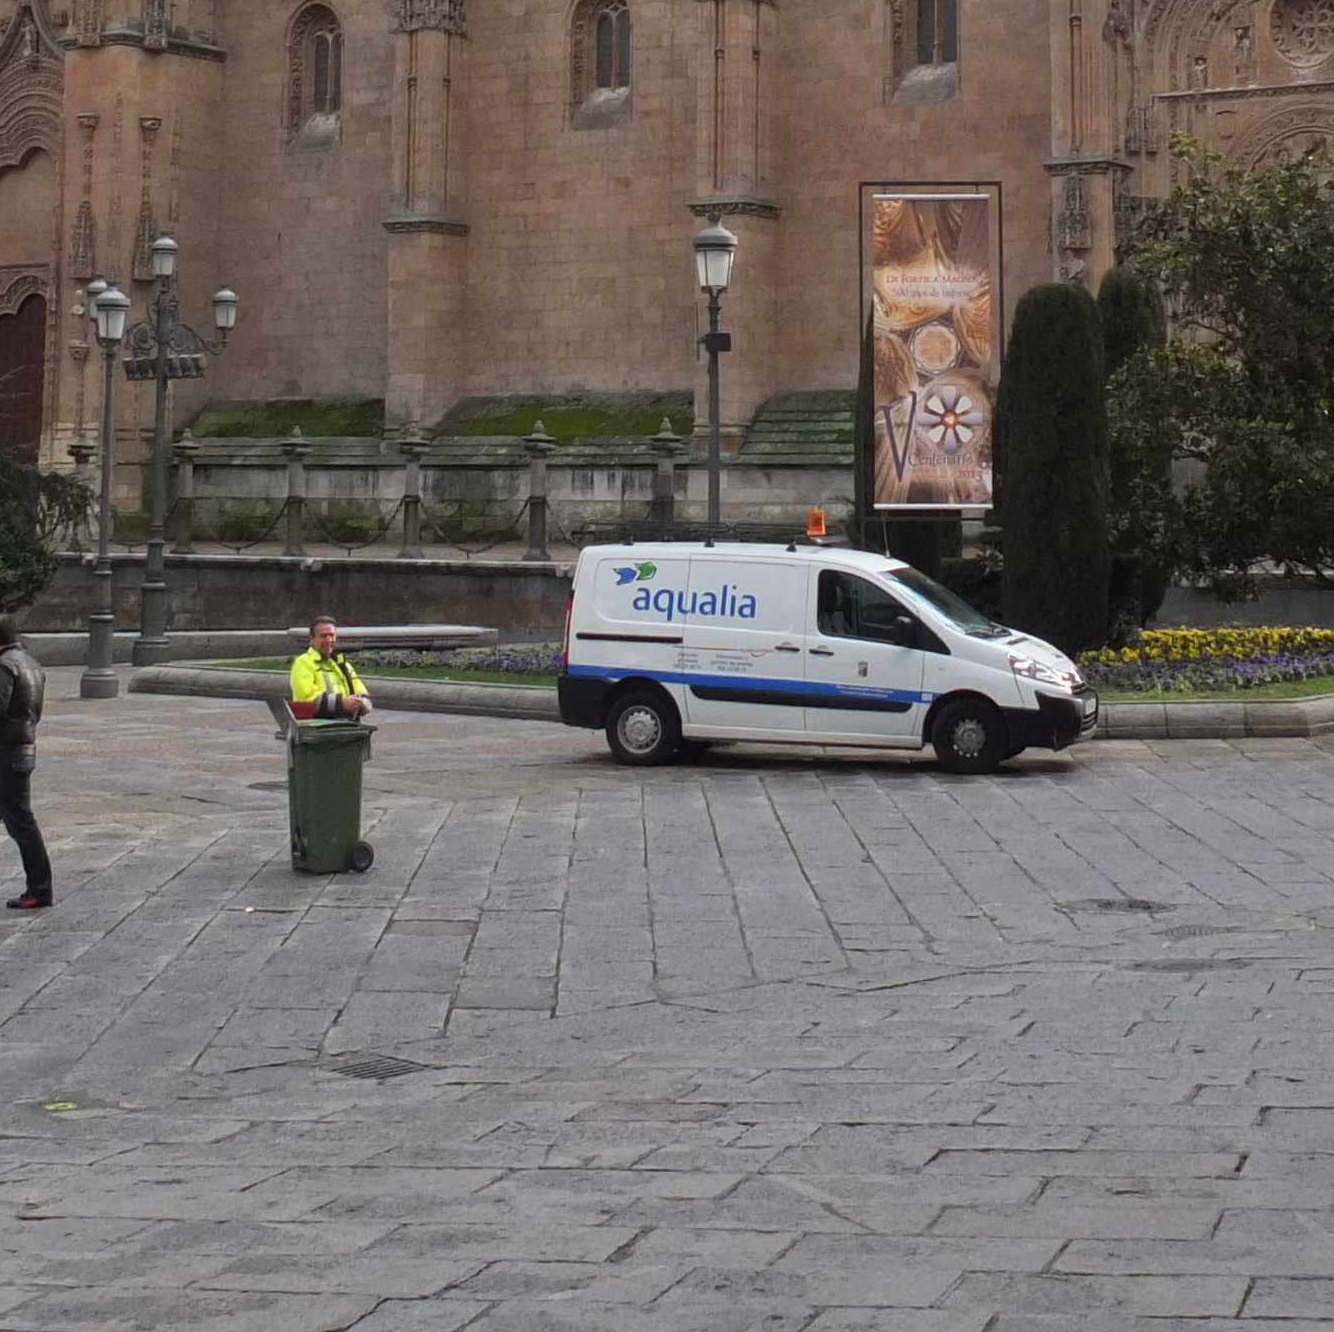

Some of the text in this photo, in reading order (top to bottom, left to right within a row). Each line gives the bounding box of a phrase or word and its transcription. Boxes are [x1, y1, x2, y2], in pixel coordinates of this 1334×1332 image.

[908, 453, 974, 467] Centenario
[958, 470, 983, 482] 2013
[632, 584, 757, 622] aqualia
